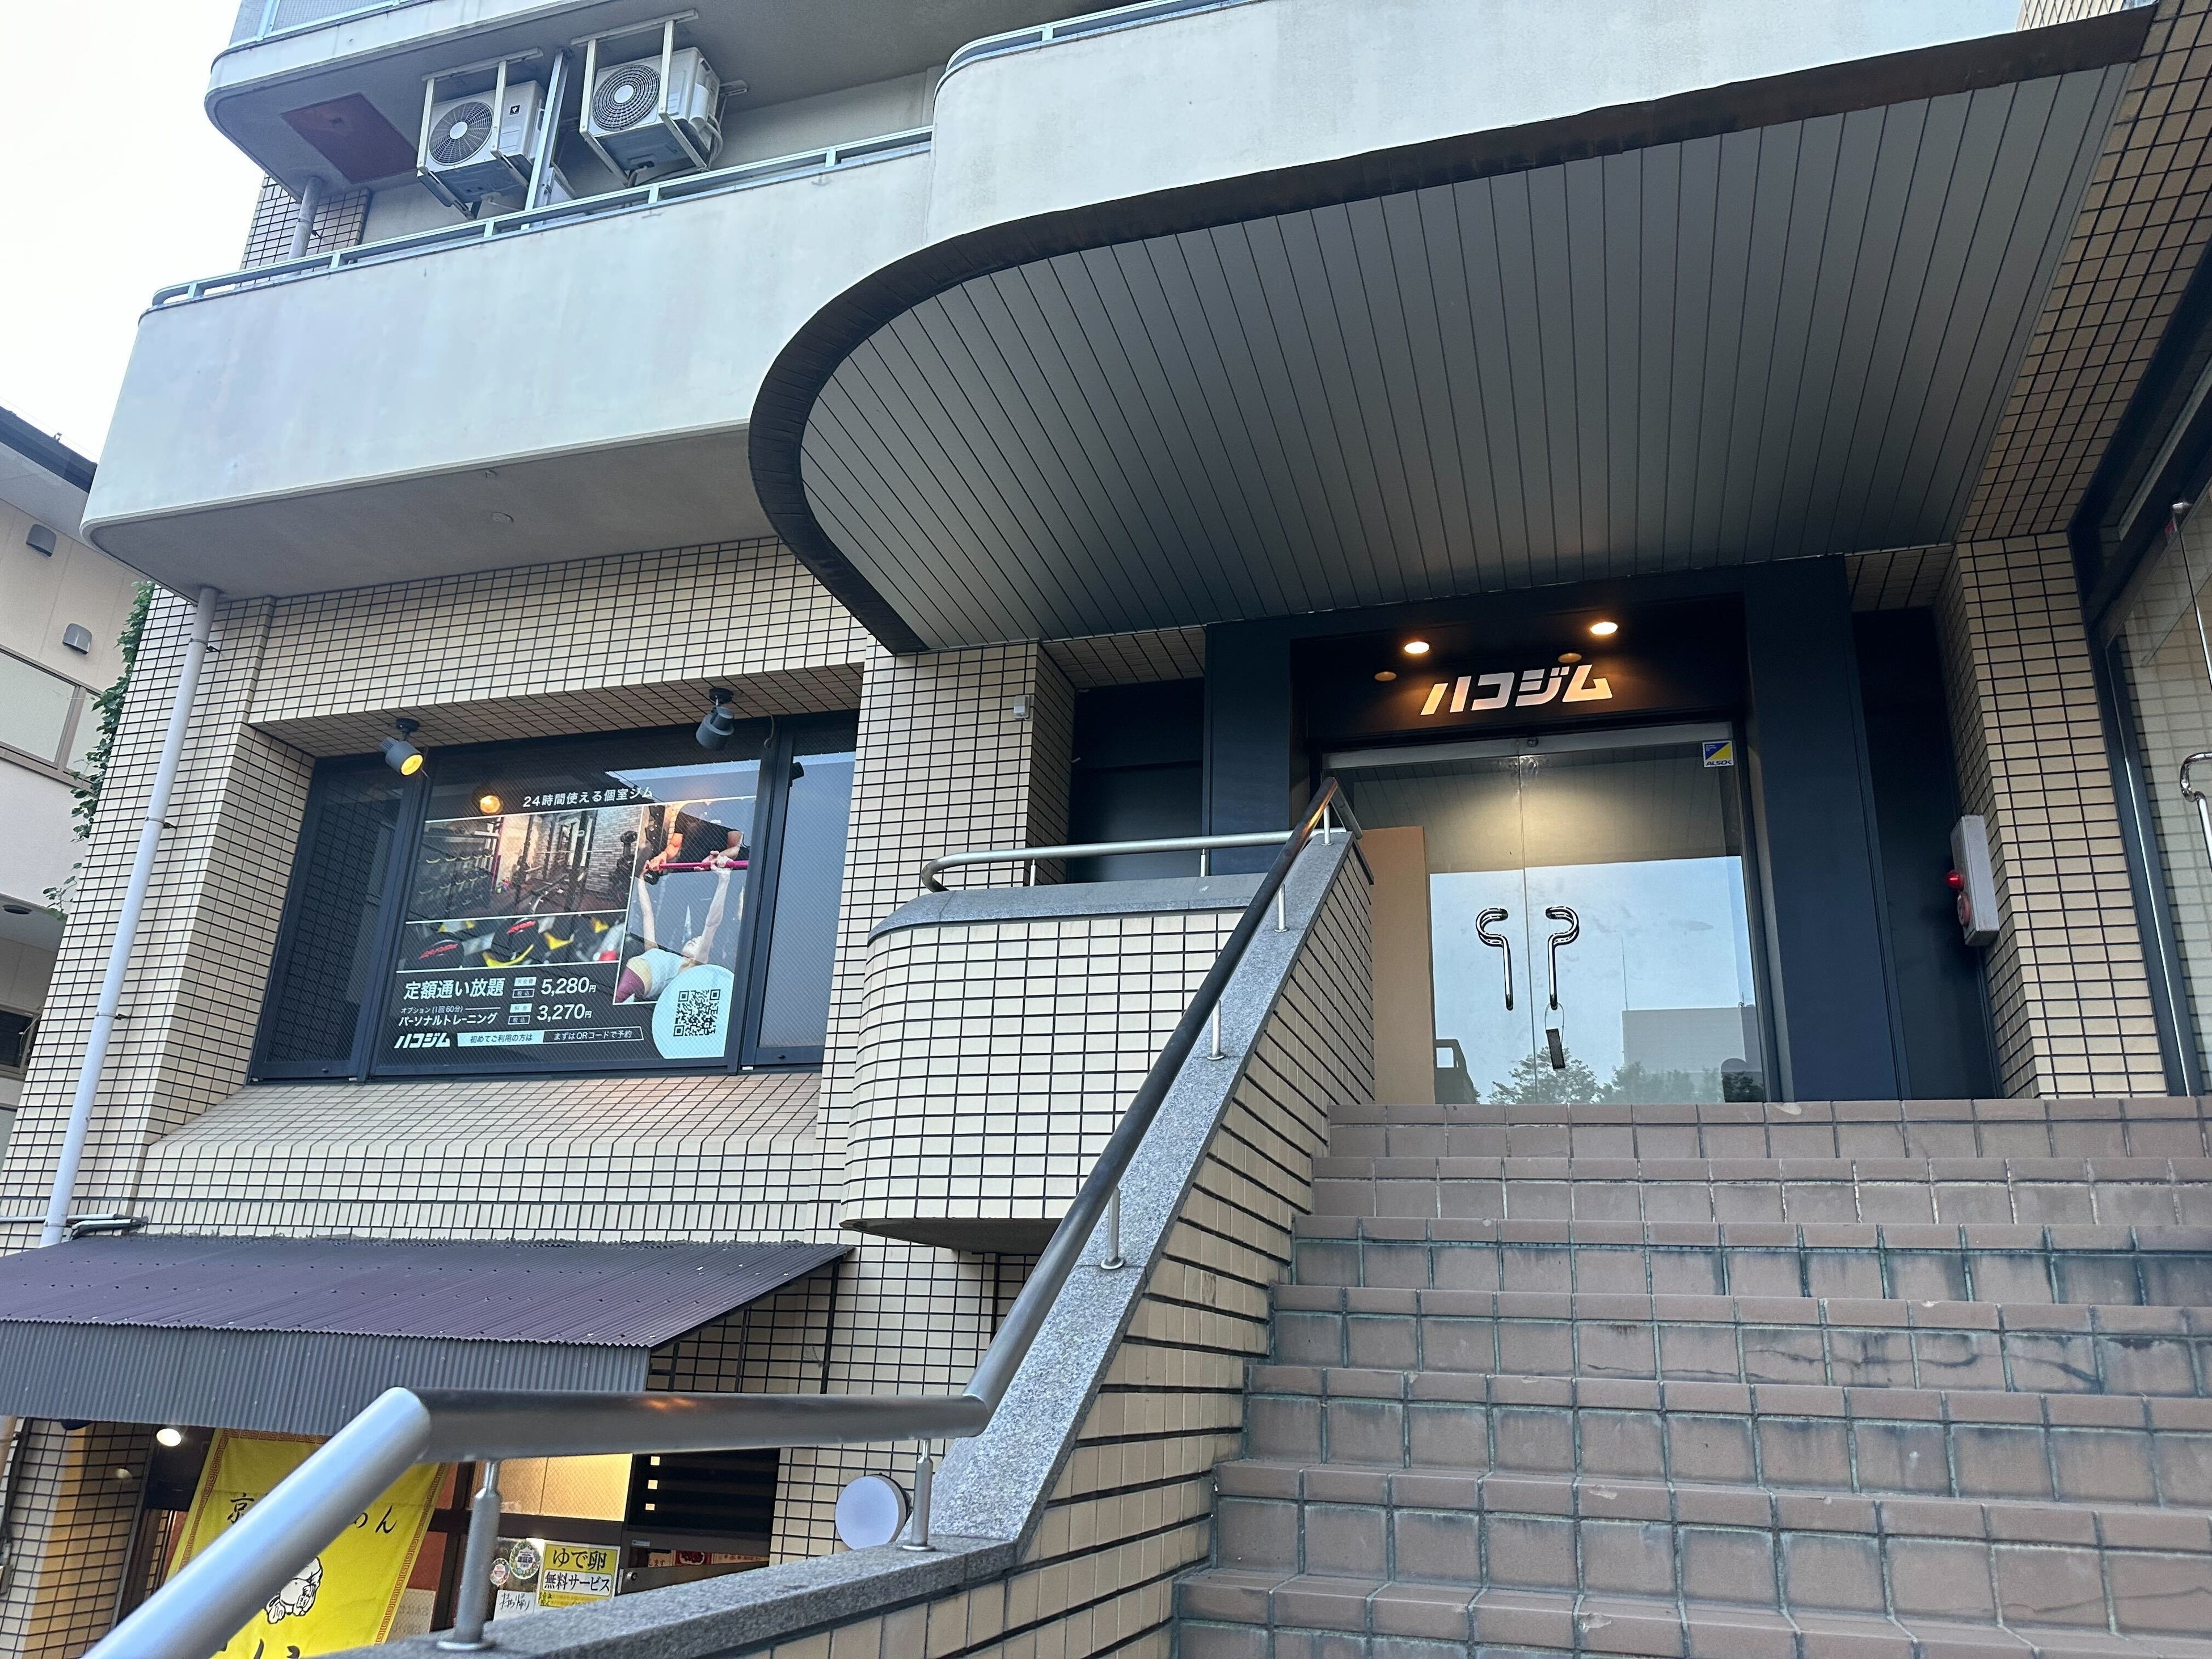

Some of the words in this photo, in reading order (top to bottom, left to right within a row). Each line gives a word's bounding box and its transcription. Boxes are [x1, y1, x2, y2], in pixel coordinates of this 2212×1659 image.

[1420, 664, 1612, 715] ハコジム
[522, 786, 653, 808] 24時間使える個室ジム
[403, 977, 506, 1000] 定額通い放題
[541, 977, 597, 997] 5,280円
[398, 1012, 498, 1027] パーソナルトレーニング
[537, 1003, 592, 1023] 3,270円
[394, 1032, 450, 1048] ハコジム
[470, 1033, 533, 1043] 初めてご利用の方は
[553, 1029, 633, 1041] まずはQRコードで予約
[552, 1547, 607, 1571] ゆで卵
[543, 1571, 610, 1592] 無料サービス
